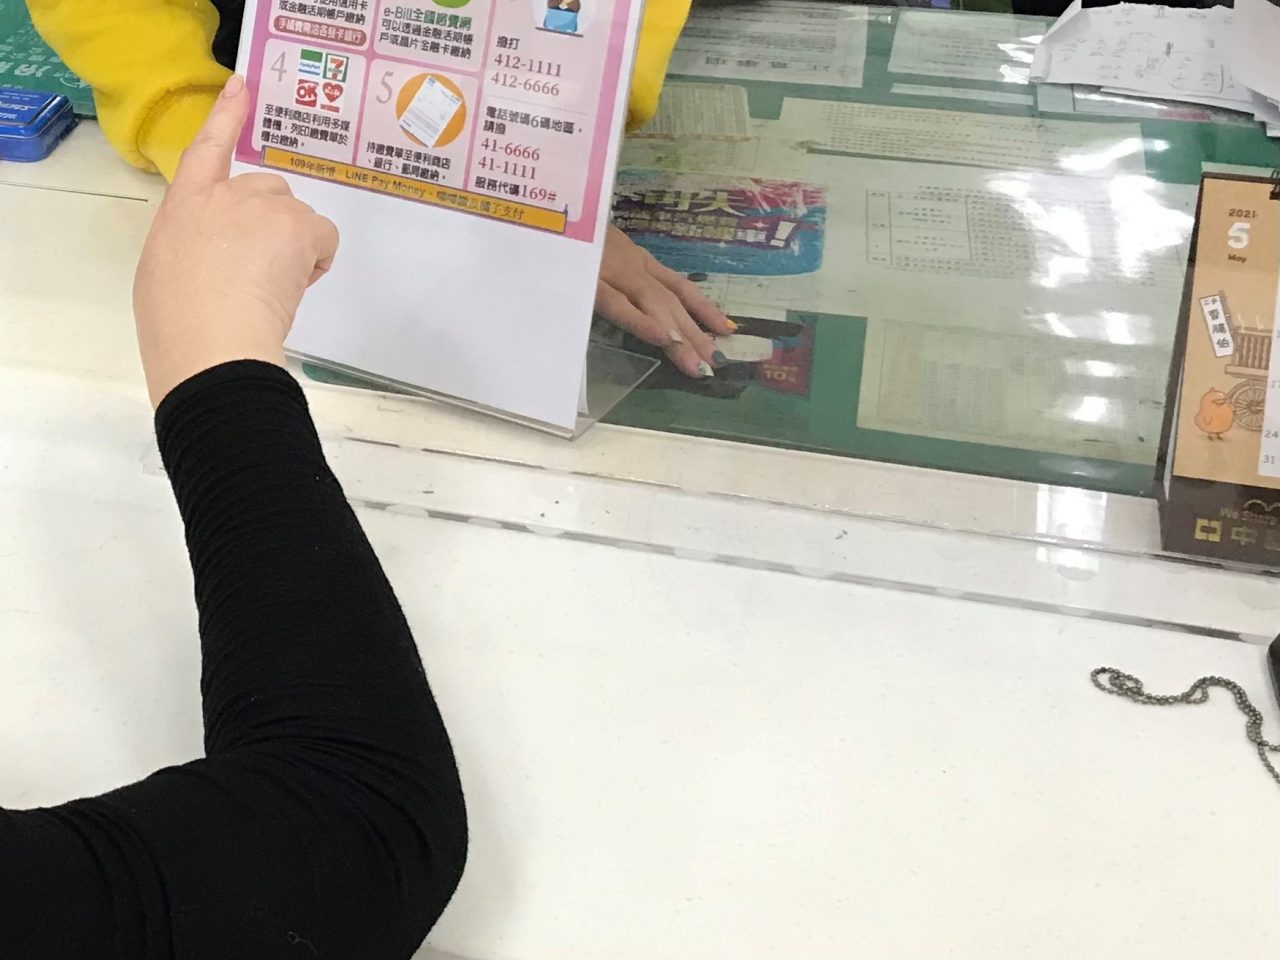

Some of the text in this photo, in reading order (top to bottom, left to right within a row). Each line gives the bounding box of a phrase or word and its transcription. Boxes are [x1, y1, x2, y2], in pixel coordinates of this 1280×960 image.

[269, 50, 288, 83] 4
[493, 53, 563, 78] 412-1111
[295, 84, 318, 100] OK
[375, 70, 395, 104] 5
[490, 72, 561, 97] 412-6666
[480, 137, 541, 162] 41-6666
[477, 155, 537, 181] 41-1111
[1226, 221, 1251, 249] 5
[1227, 253, 1248, 264] May
